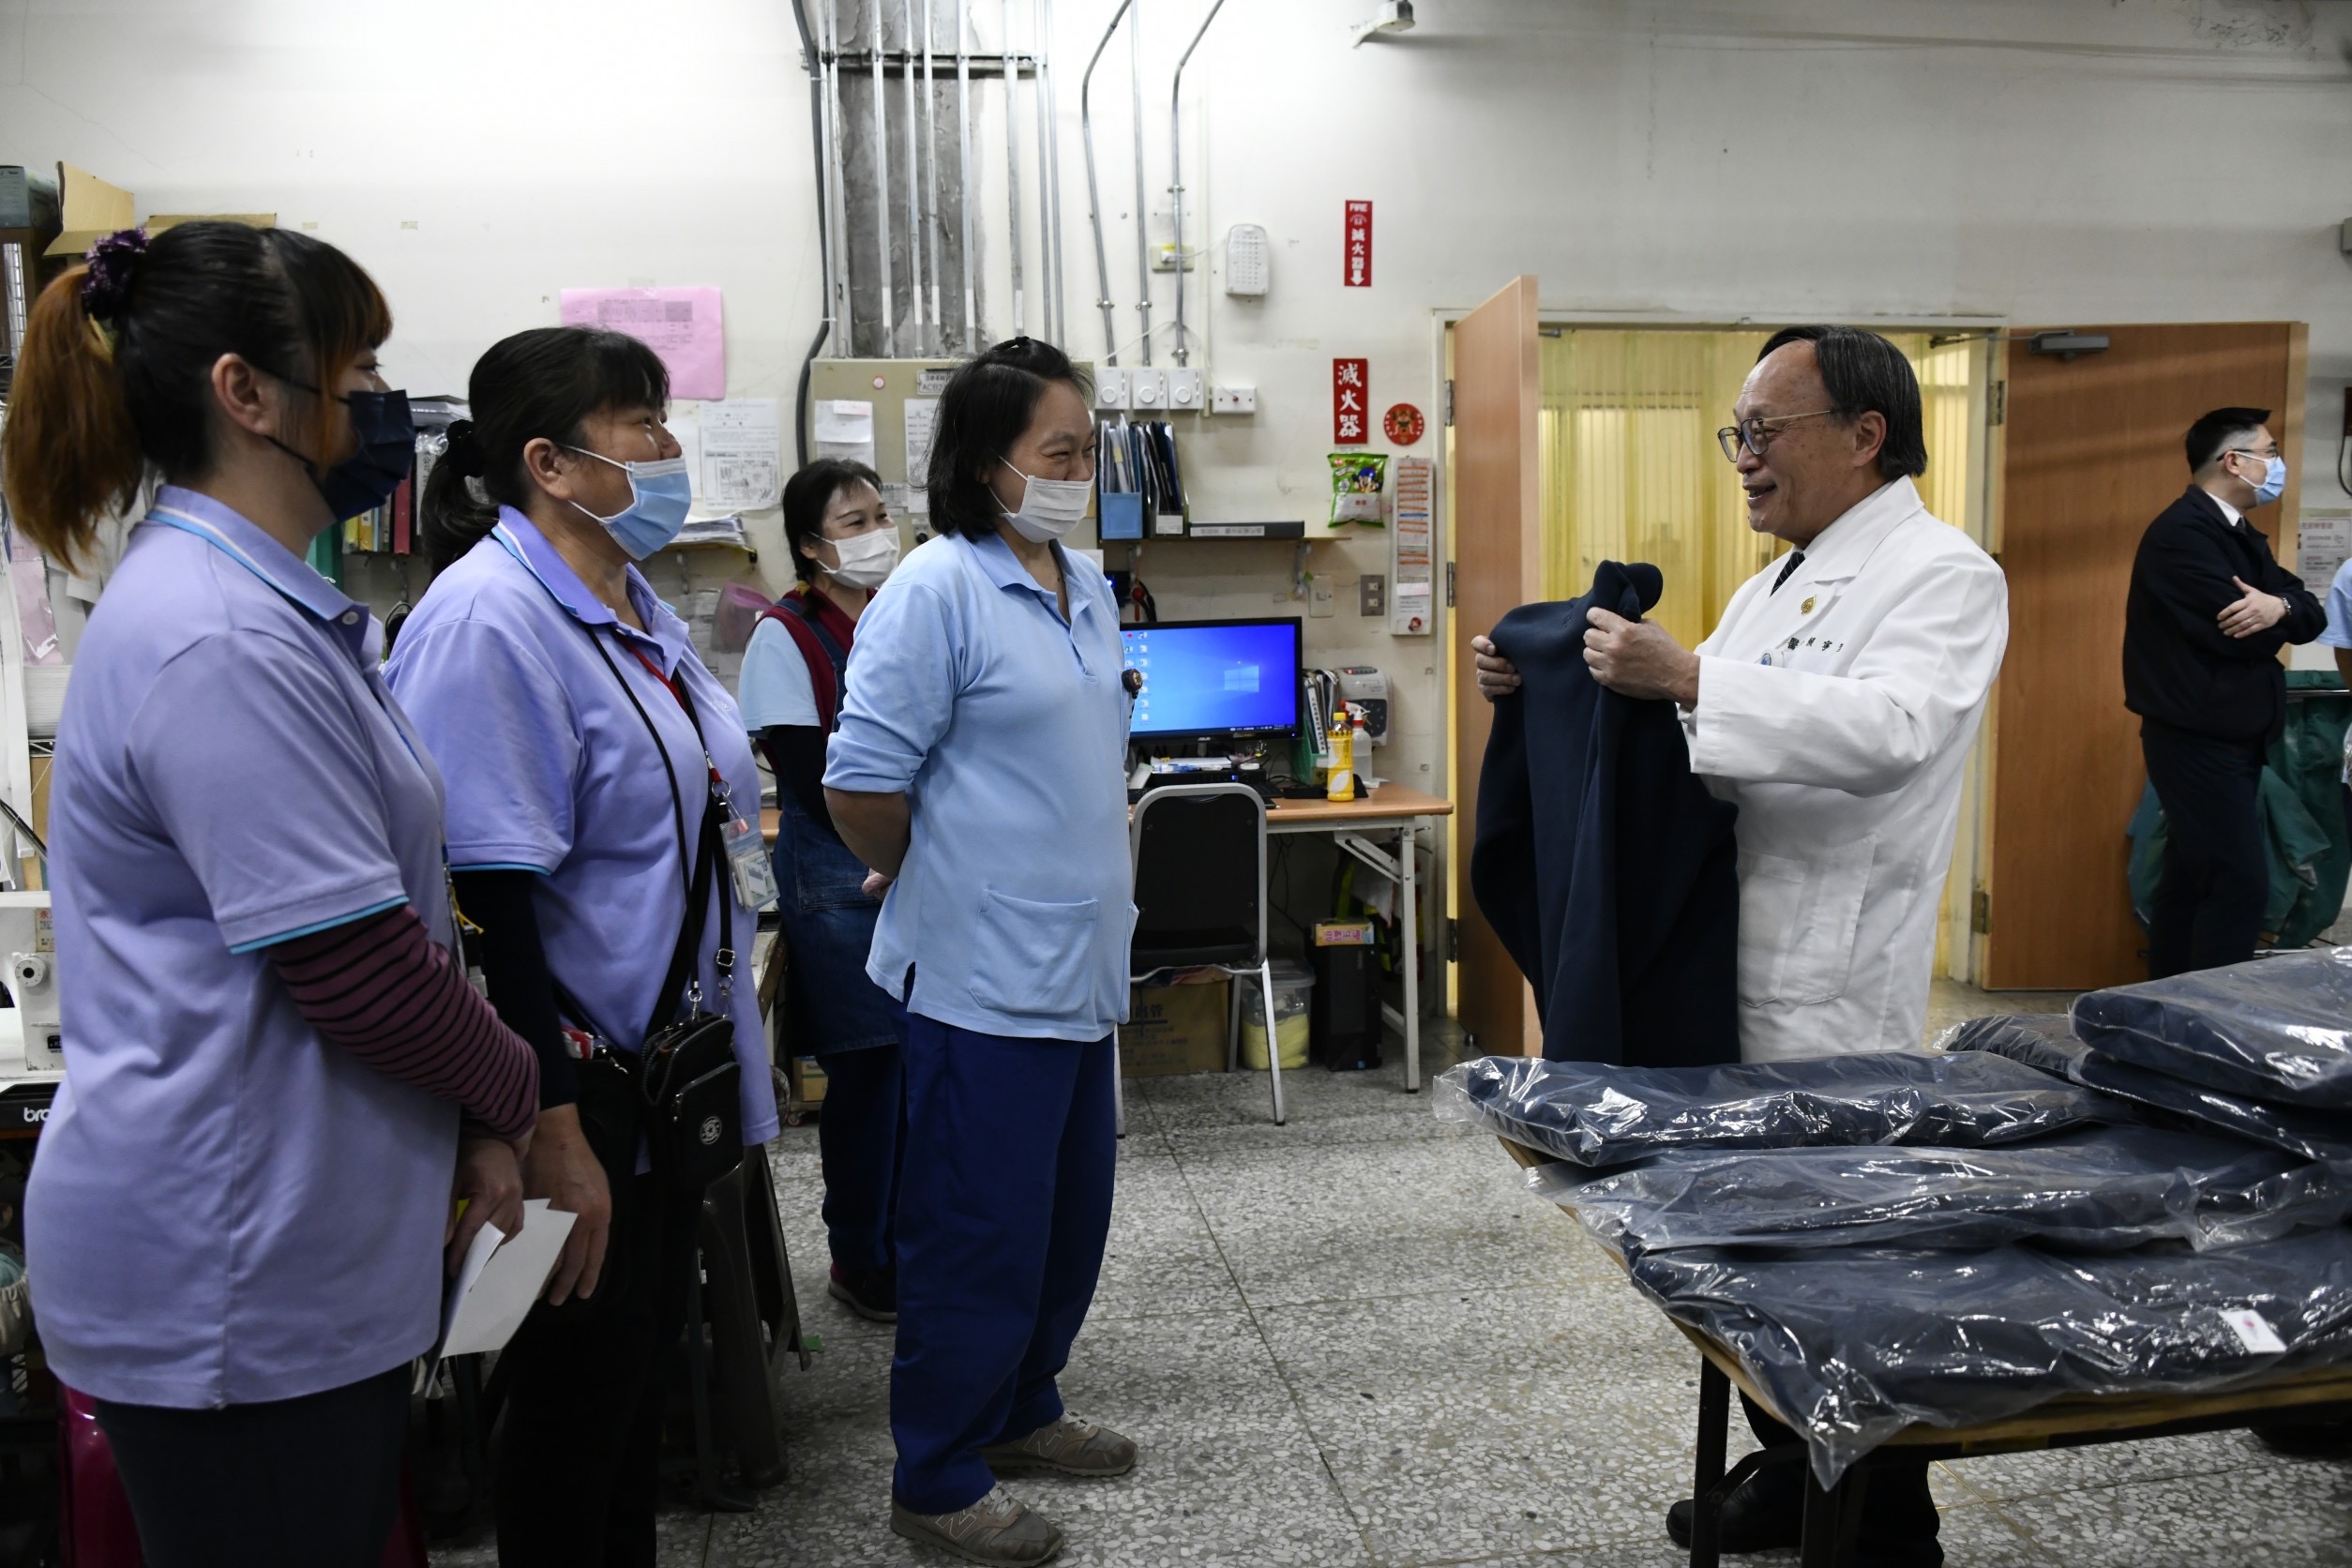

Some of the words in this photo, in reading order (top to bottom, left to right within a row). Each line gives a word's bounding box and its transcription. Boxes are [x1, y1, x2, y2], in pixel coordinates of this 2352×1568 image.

[1349, 203, 1367, 212] FIRE
[1351, 228, 1364, 270] 滅火器
[1337, 362, 1362, 437] 滅火器
